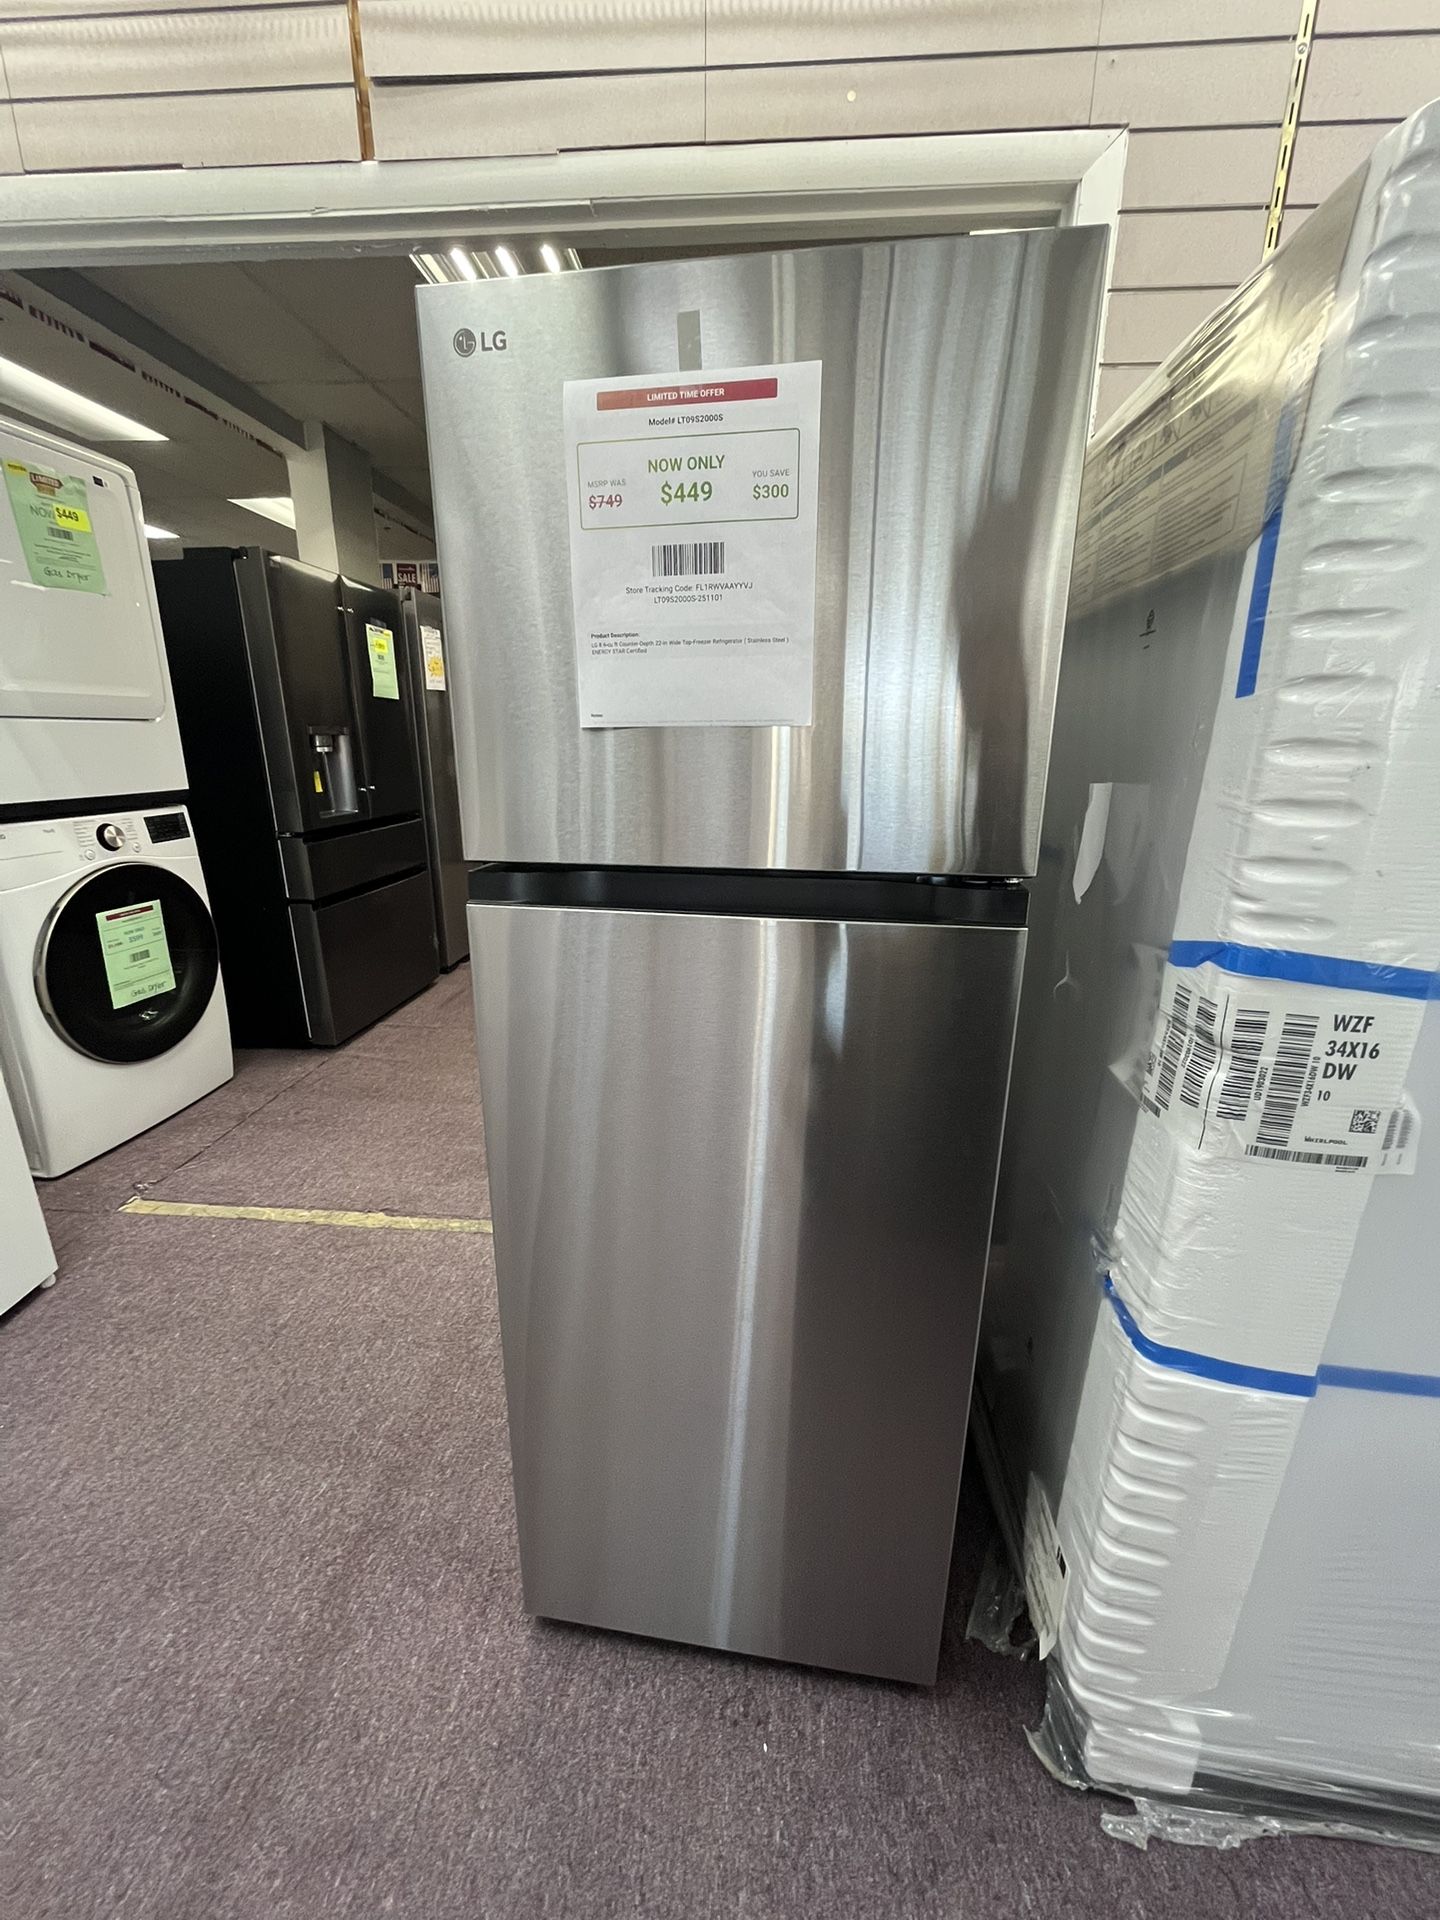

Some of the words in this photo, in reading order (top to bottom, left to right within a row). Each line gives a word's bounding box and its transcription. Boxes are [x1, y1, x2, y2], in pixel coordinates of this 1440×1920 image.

[480, 330, 507, 352] LG
[647, 392, 678, 402] LIMITED
[680, 390, 699, 400] TIME
[700, 388, 725, 398] OFFER
[648, 416, 676, 426] Model#
[678, 413, 724, 425] LT09S2000S
[648, 457, 683, 474] NOW
[687, 455, 726, 471] ONLY
[752, 470, 768, 478] YOU
[769, 468, 790, 478] SAVE
[587, 479, 609, 489] MSRP
[610, 478, 627, 487] WAS
[660, 480, 713, 506] $449
[752, 483, 789, 500] $300
[589, 494, 623, 510] $749
[55, 507, 80, 522] $449
[398, 572, 416, 584] SALE
[625, 586, 643, 594] Store
[645, 585, 673, 594] Tracking
[1333, 1013, 1375, 1034] WZF
[1324, 1039, 1380, 1060] 34X16
[1321, 1062, 1358, 1081] DW
[1317, 1089, 1331, 1102] 10
